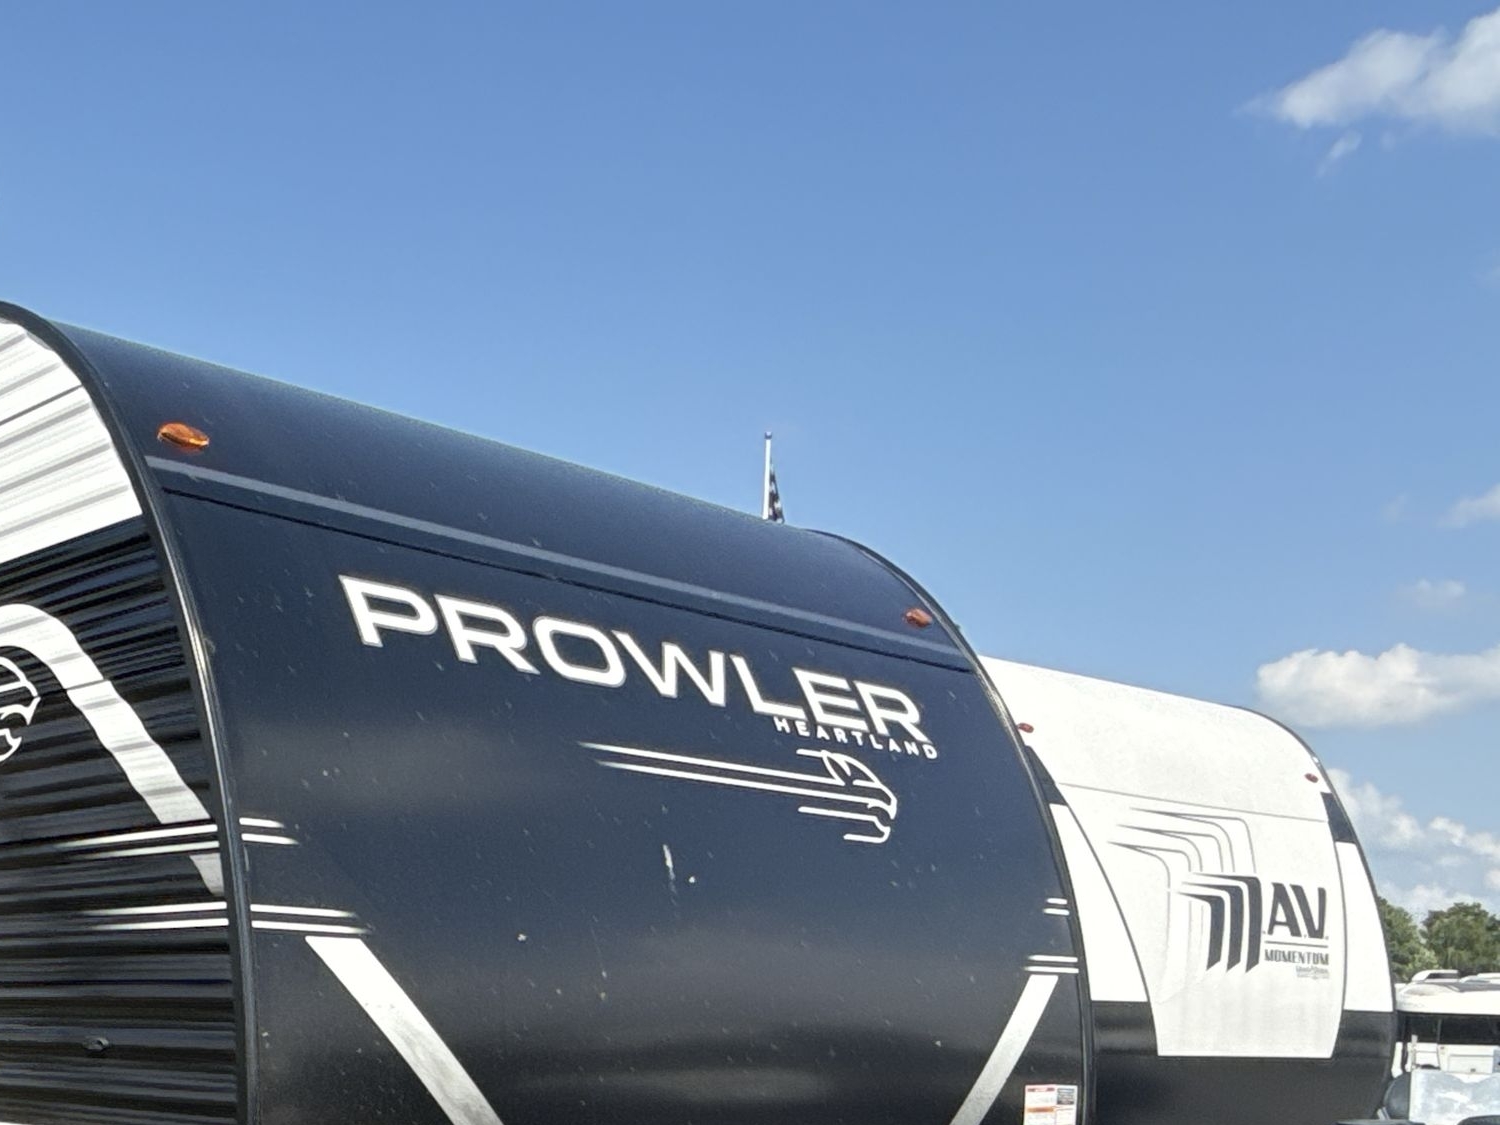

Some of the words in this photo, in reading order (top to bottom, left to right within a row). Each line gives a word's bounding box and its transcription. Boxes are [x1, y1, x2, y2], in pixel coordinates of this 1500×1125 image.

[338, 574, 934, 744] PROWLER
[773, 716, 939, 760] HEARTLAND
[1264, 948, 1329, 966] MOMENTUM
